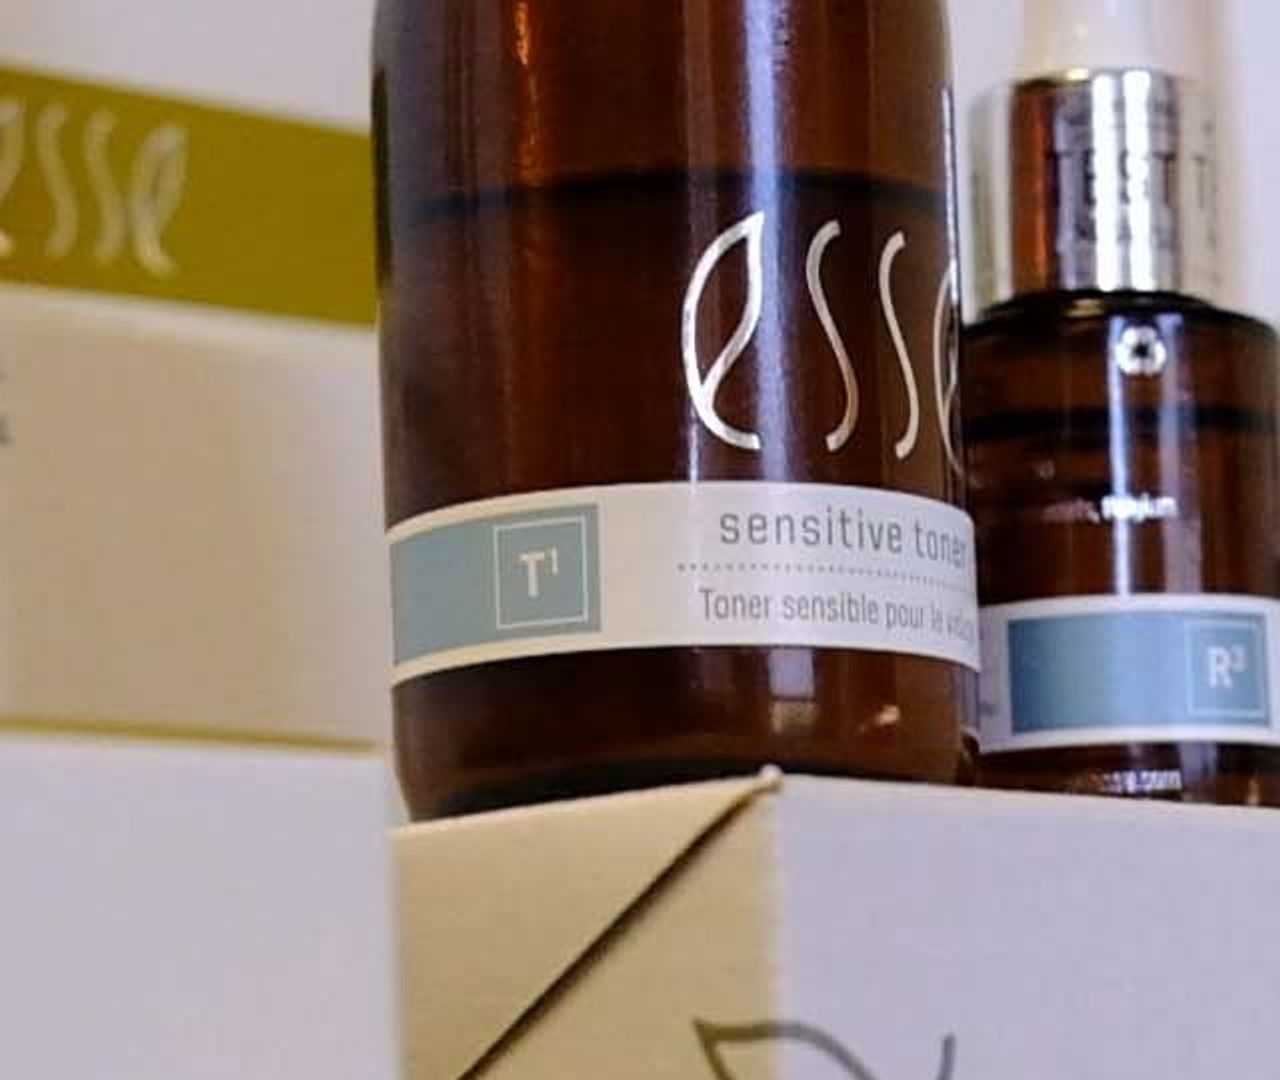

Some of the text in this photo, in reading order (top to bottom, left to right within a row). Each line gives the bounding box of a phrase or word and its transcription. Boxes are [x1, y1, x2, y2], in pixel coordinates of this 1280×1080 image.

[718, 504, 968, 571] sensitive toner
[698, 585, 771, 621] Toner
[783, 592, 880, 626] sensible
[885, 599, 925, 631] pour
